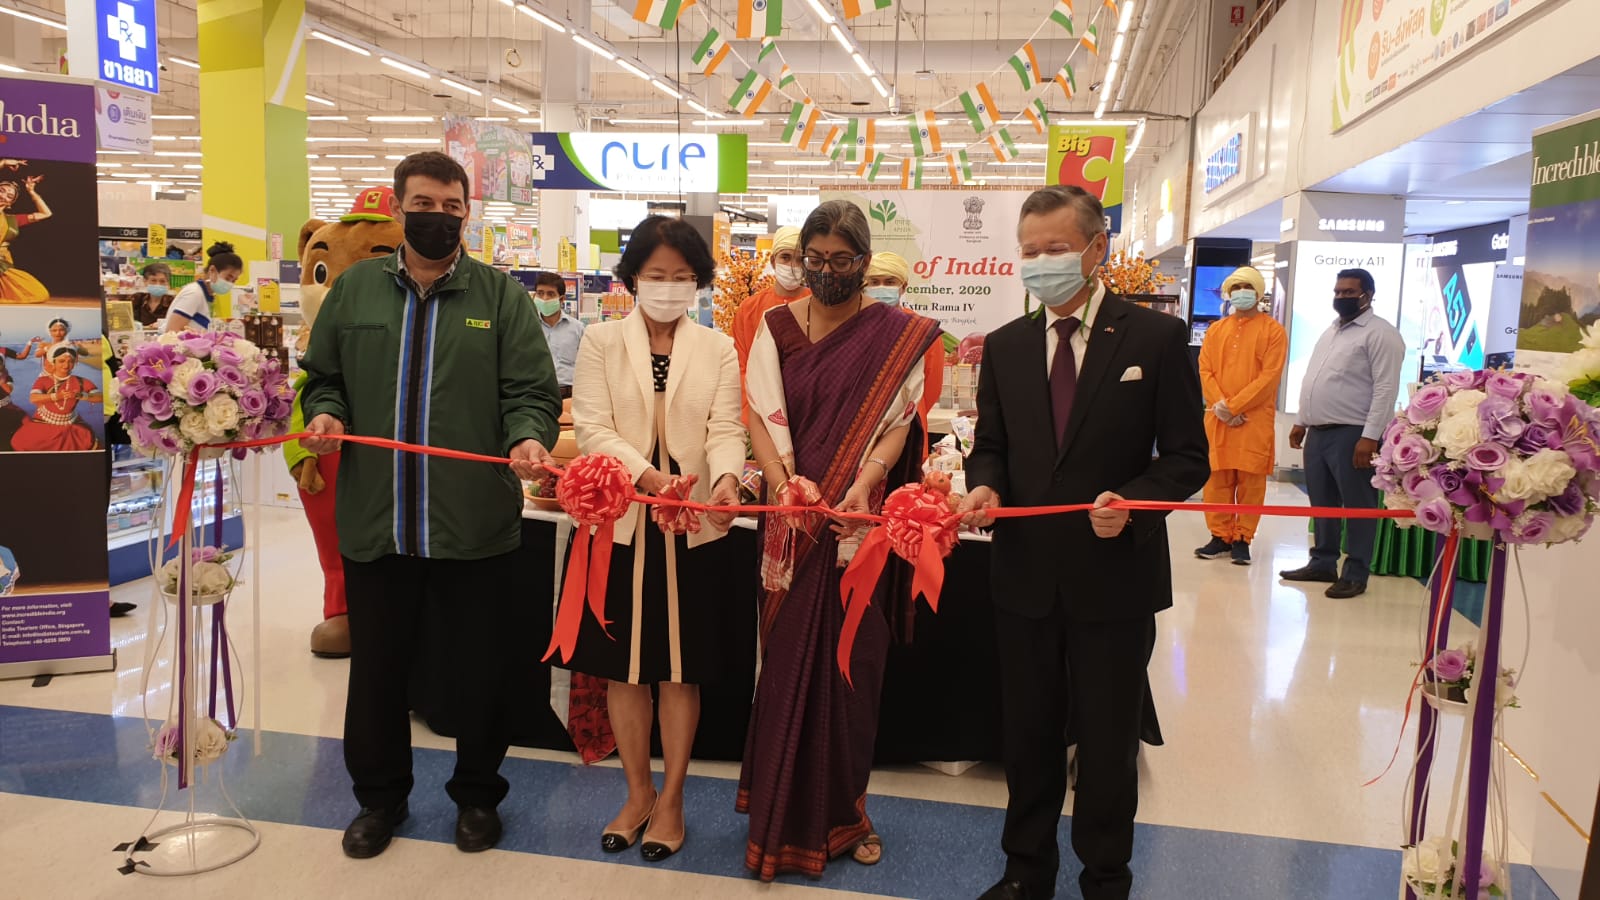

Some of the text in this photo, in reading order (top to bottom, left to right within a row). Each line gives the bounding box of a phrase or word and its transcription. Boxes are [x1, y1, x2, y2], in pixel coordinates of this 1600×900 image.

[104, 59, 153, 88] ขายยา
[1058, 135, 1091, 157] Big
[1058, 135, 1116, 203] C
[1318, 218, 1385, 232] SAMSUNG
[913, 256, 1014, 279] of India
[1314, 255, 1385, 267] Galaxy A11
[906, 284, 991, 296] cember, 2020
[931, 302, 960, 312] Rama
[963, 303, 975, 312] IV
[1442, 271, 1467, 343] A51
